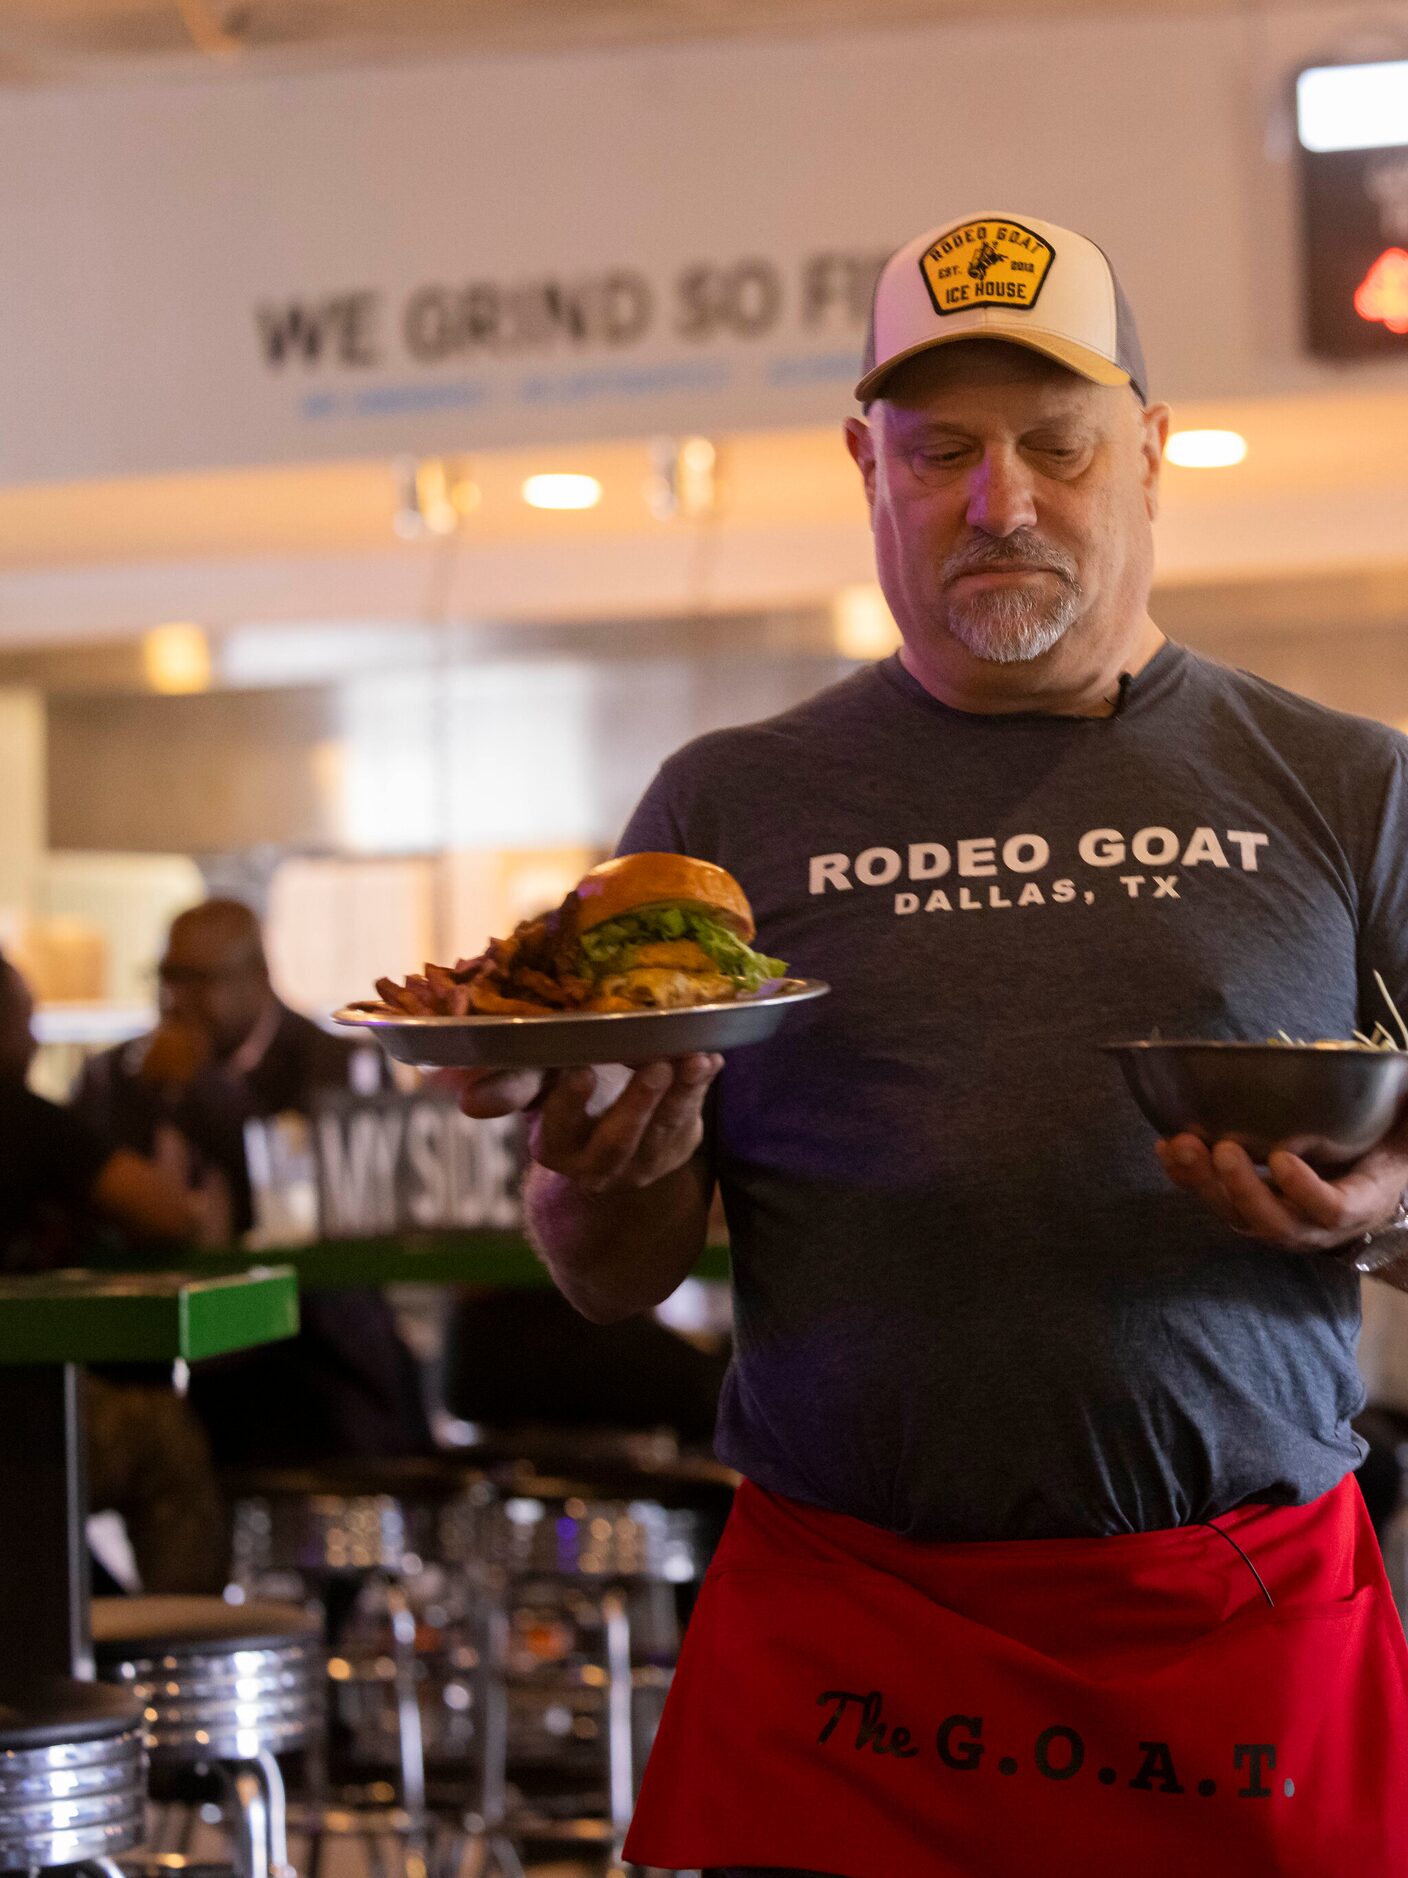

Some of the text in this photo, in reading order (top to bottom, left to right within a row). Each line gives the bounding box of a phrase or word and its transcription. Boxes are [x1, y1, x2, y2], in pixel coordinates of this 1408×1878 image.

[929, 226, 1046, 262] RODEO GOAT
[938, 265, 962, 279] EST.
[945, 281, 1027, 304] ICE HOUSE
[254, 290, 382, 370] WE
[403, 266, 652, 364] GRIND
[676, 256, 782, 345] SO
[808, 826, 1269, 895] RODEO GOAT
[894, 875, 1182, 915] DALLAS, TX
[816, 1690, 1296, 1798] The G.O.A.T.
